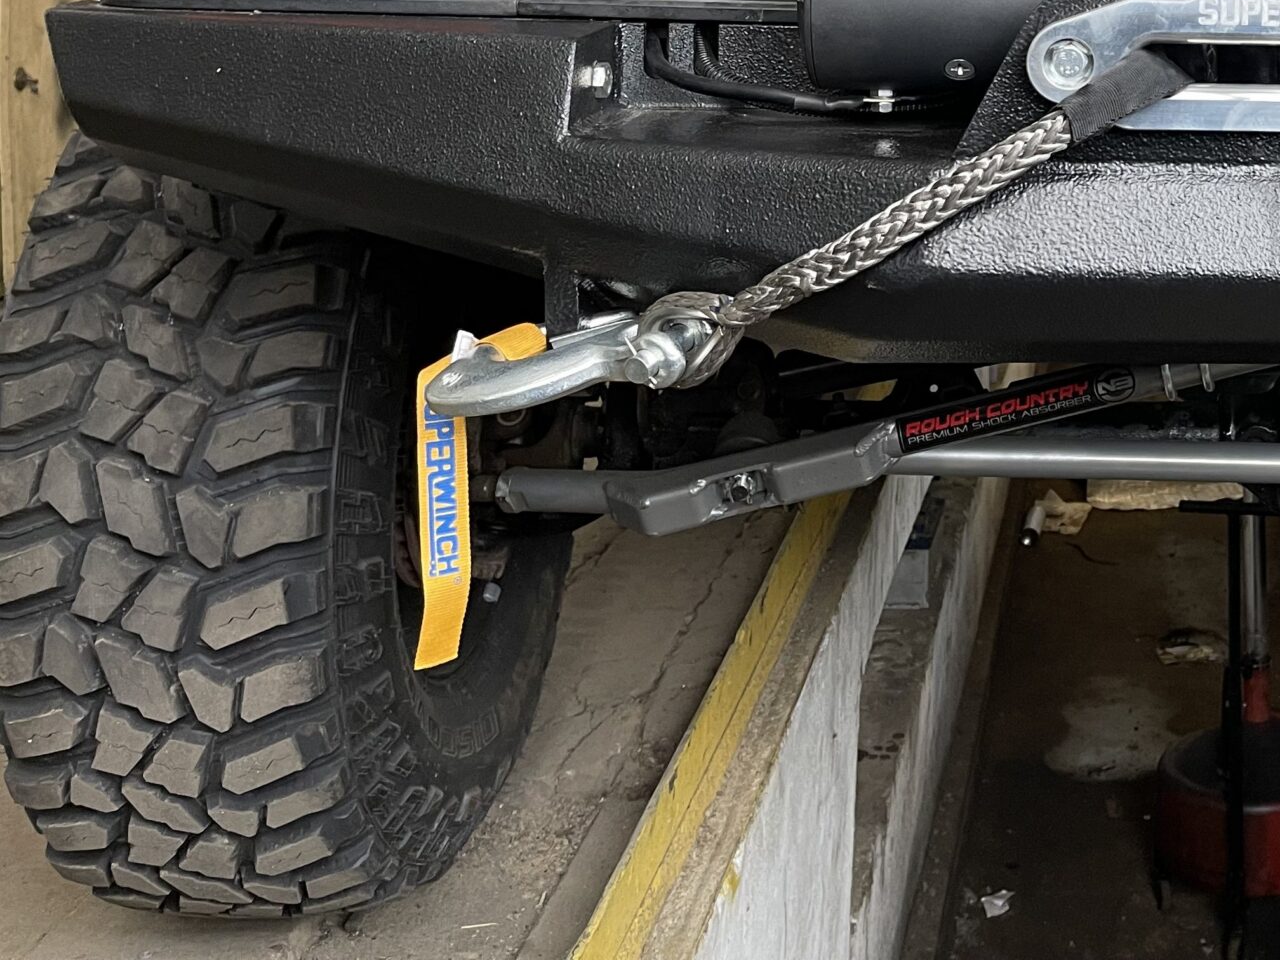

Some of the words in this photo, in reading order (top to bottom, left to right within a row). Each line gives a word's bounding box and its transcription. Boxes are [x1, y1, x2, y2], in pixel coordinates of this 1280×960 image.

[906, 407, 980, 437] ROUGH
[986, 381, 1089, 418] COUNTRY
[908, 425, 969, 445] PREMIUM
[972, 414, 1017, 430] SHOCK
[1022, 395, 1092, 418] ABSORBER
[424, 402, 460, 577] UPERWINCH
